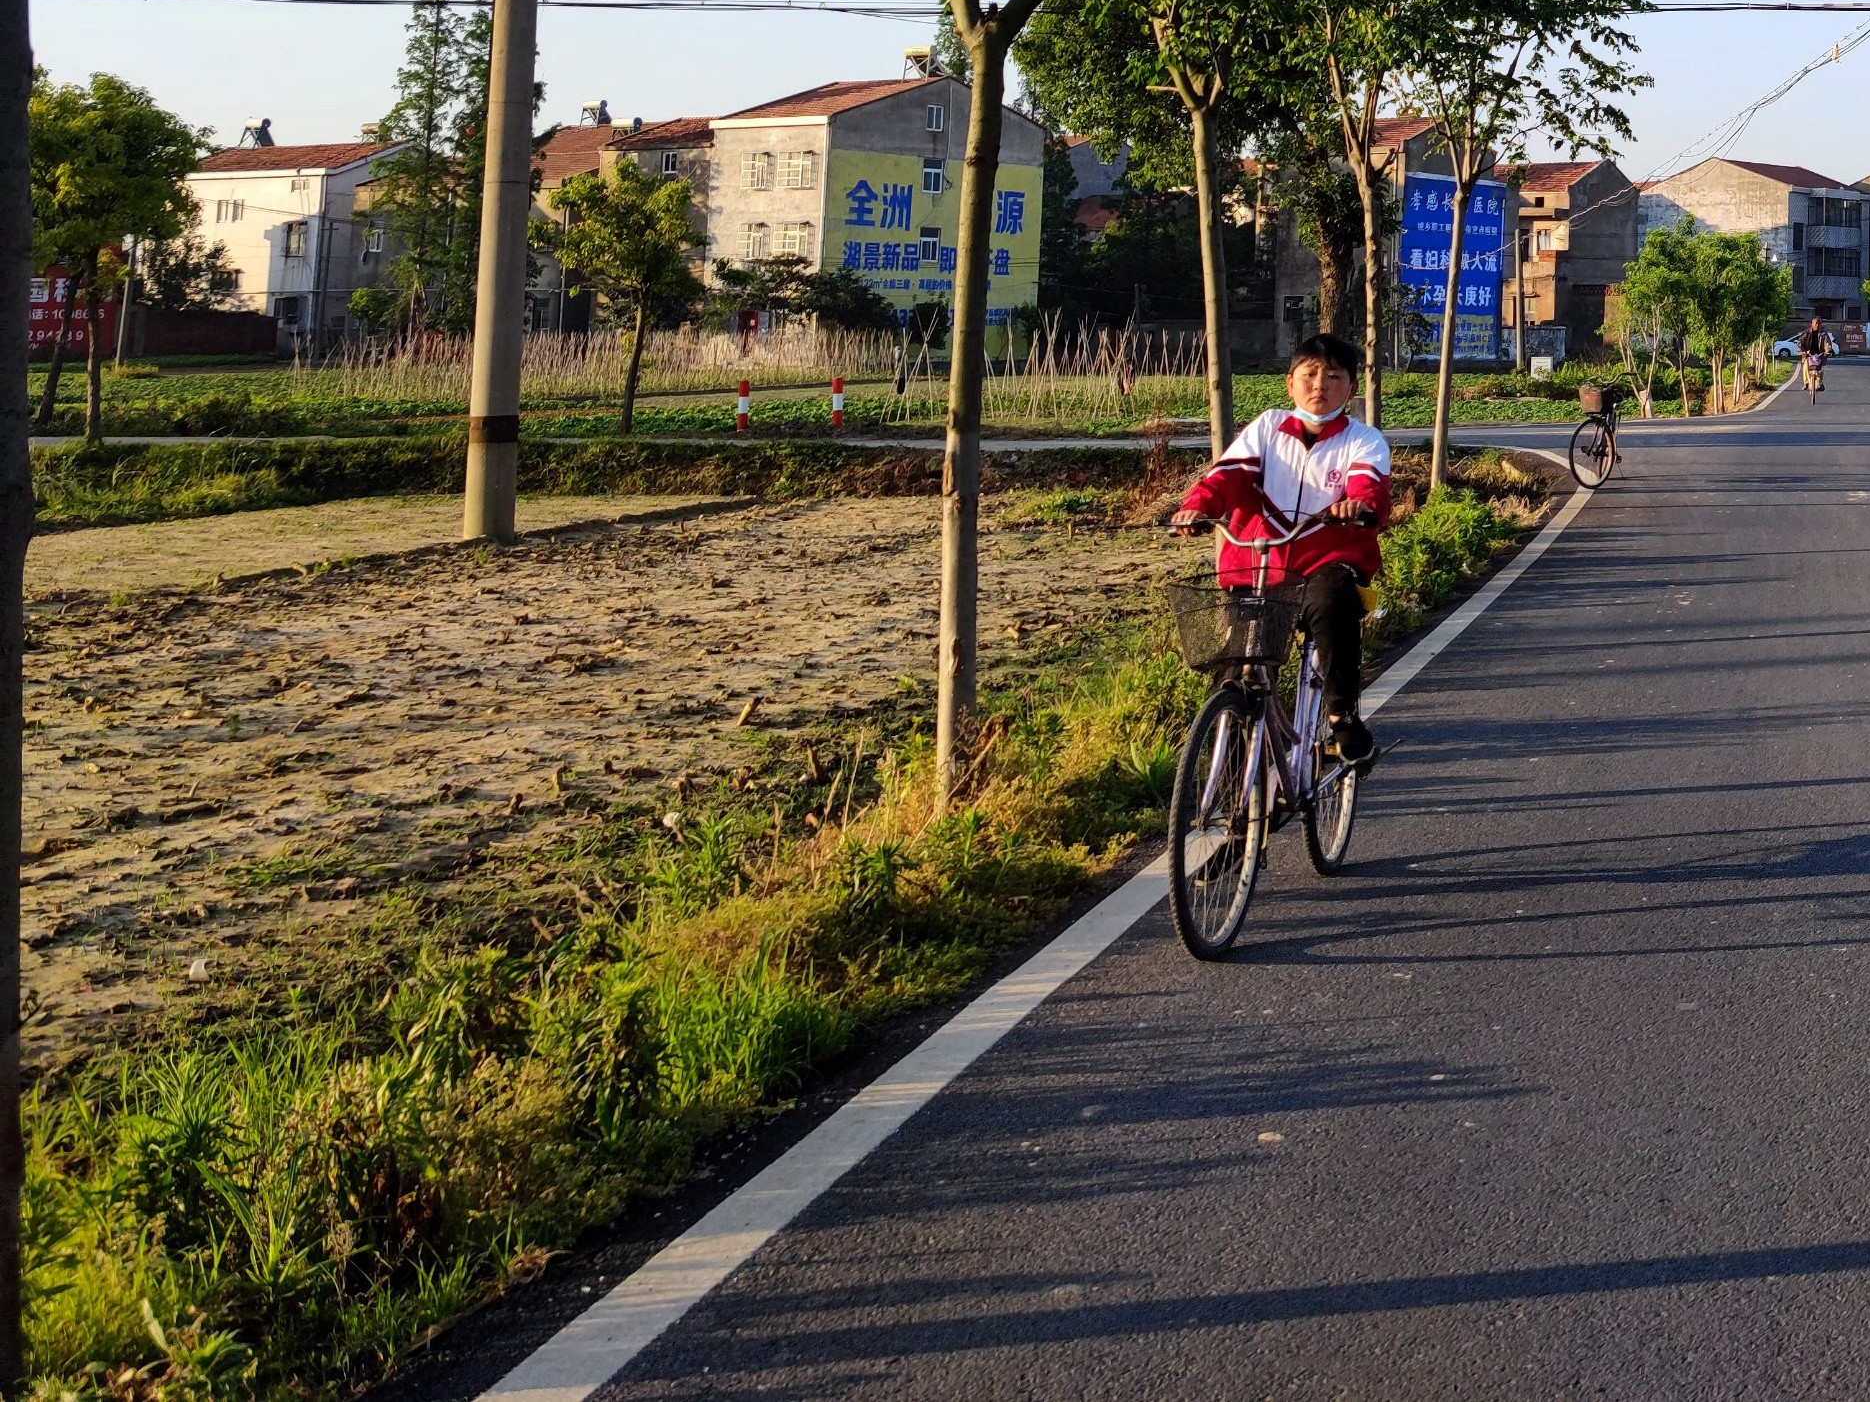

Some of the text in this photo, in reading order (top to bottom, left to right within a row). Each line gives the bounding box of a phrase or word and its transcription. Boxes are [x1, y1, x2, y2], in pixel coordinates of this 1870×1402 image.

[1410, 188, 1499, 216] 孝感长医院
[1408, 284, 1491, 307] 不孕庚好
